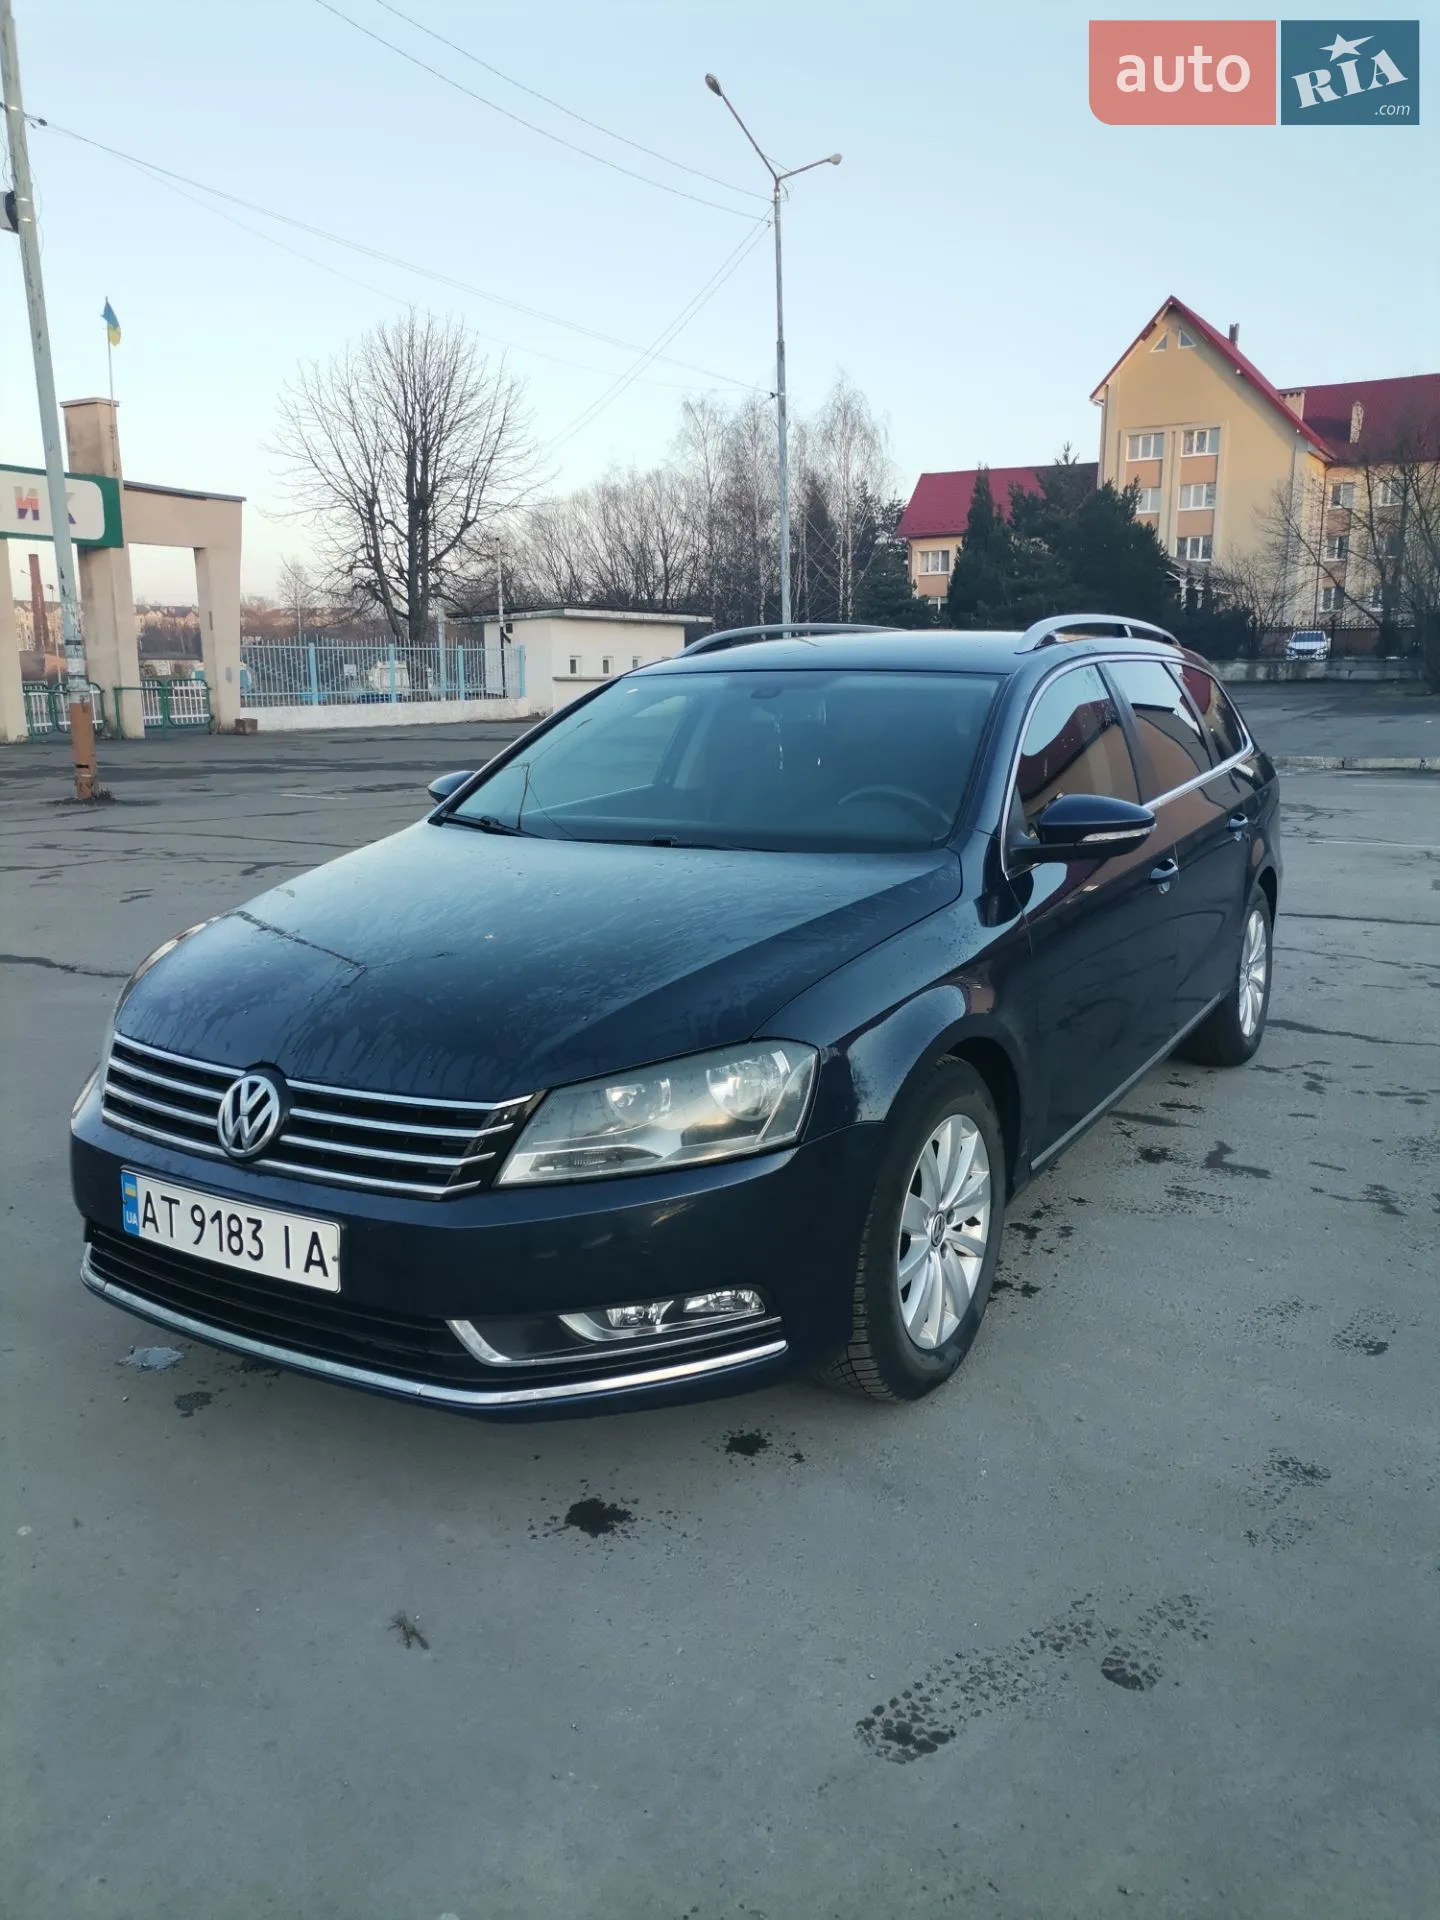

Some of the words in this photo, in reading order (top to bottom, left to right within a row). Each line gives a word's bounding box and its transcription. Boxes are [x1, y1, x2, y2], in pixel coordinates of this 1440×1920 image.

[126, 1211, 138, 1224] UA
[142, 1190, 180, 1238] AT
[190, 1204, 264, 1261] 9183
